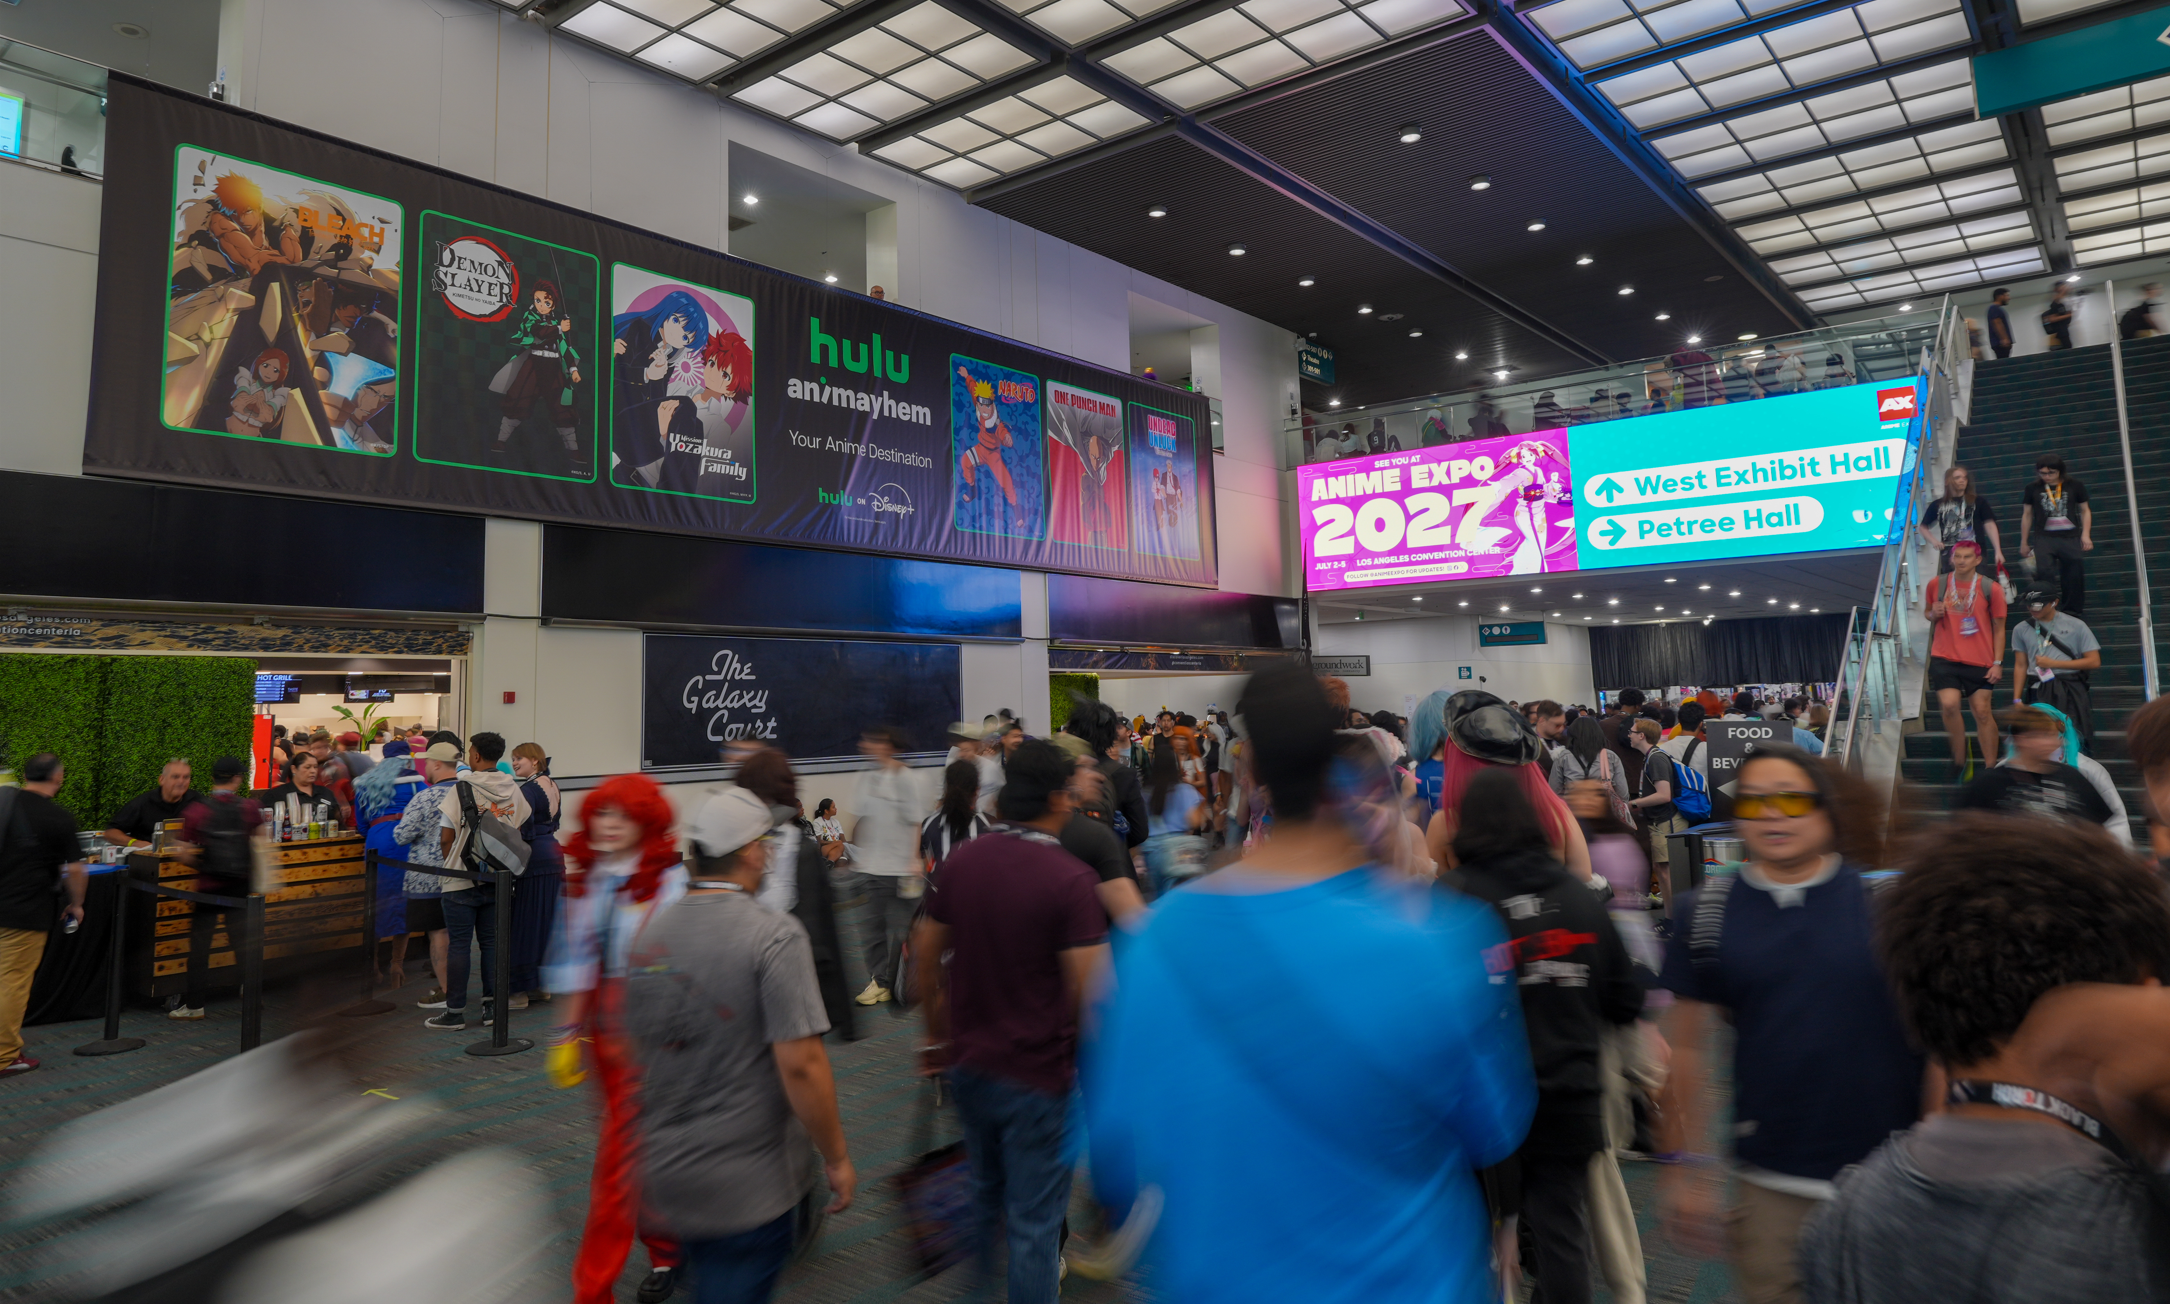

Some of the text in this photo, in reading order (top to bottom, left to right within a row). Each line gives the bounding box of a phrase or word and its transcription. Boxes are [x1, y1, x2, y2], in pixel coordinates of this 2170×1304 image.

[297, 206, 385, 246] BLEACH
[434, 241, 516, 285] DEMON
[431, 268, 517, 307] SLAYER
[452, 292, 474, 301] KIMETSU
[481, 298, 496, 306] YAIBA
[810, 316, 910, 384] hulu
[787, 376, 931, 426] animayhem
[998, 380, 1036, 403] NARUTO
[1054, 389, 1117, 418] ONE PUNCH MAN
[1879, 395, 1914, 412] AX
[669, 432, 732, 459] Yozakura
[680, 434, 702, 443] Mission
[788, 429, 933, 469] Your Anime Destination
[1374, 455, 1421, 468] SEE YOU AT
[1634, 446, 1891, 496] West Exhibit Hall
[1311, 456, 1495, 502] ANIME EXPO
[818, 487, 853, 507] hulu
[856, 497, 866, 505] ON
[1312, 485, 1497, 558] 2027
[1638, 503, 1801, 540] Petree Hall
[1315, 560, 1346, 570] JULY 2-5
[1356, 547, 1501, 567] LOS ANGELES CONVENTION CENTER
[1370, 569, 1405, 578] @ANIMEEXPO
[705, 649, 756, 681] The
[1312, 659, 1364, 671] groundwork
[682, 675, 768, 714] Galaxy
[707, 709, 777, 742] Court
[1727, 727, 1773, 739] FOOD
[1744, 742, 1755, 754] &
